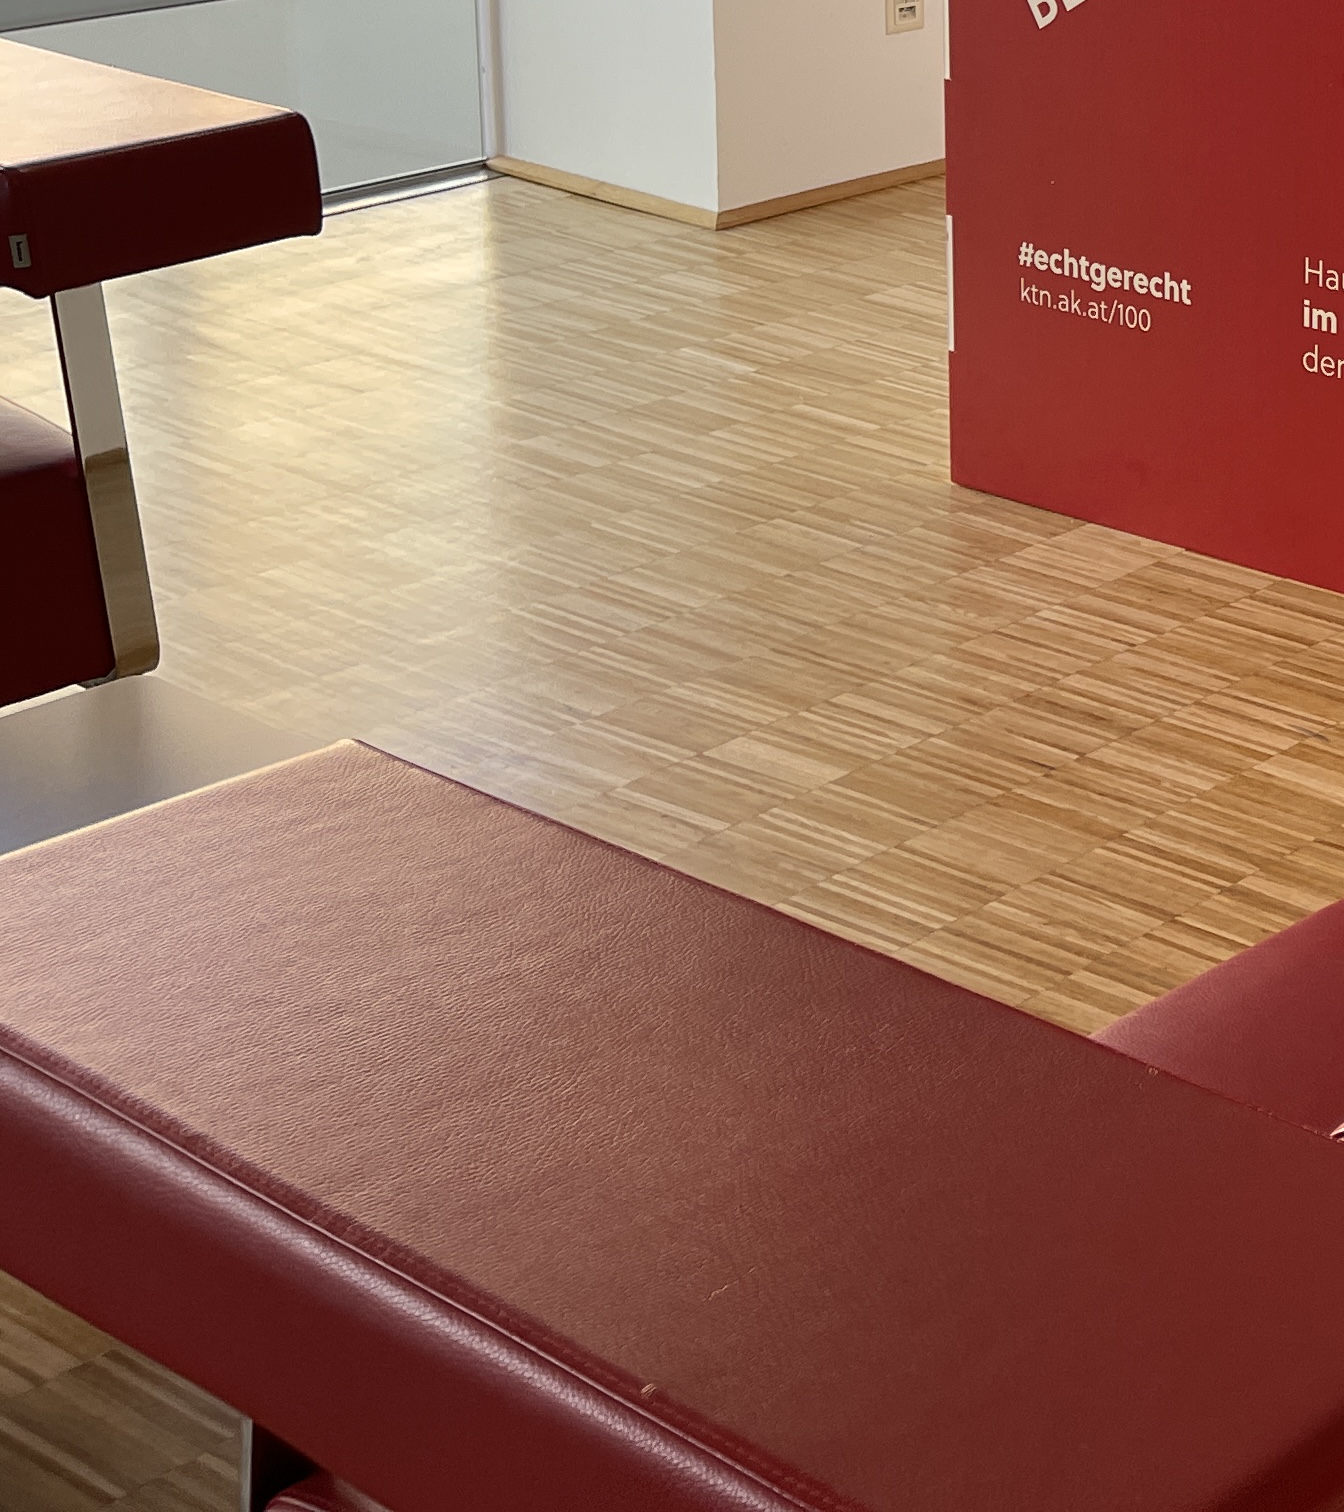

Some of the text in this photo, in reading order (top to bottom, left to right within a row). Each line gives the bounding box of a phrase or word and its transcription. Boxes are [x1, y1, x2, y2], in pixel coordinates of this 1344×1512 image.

[1017, 242, 1192, 306] #echtgerecht
[1019, 279, 1152, 333] ktn.ak.at/100
[1303, 301, 1338, 334] im
[1302, 347, 1344, 380] der
